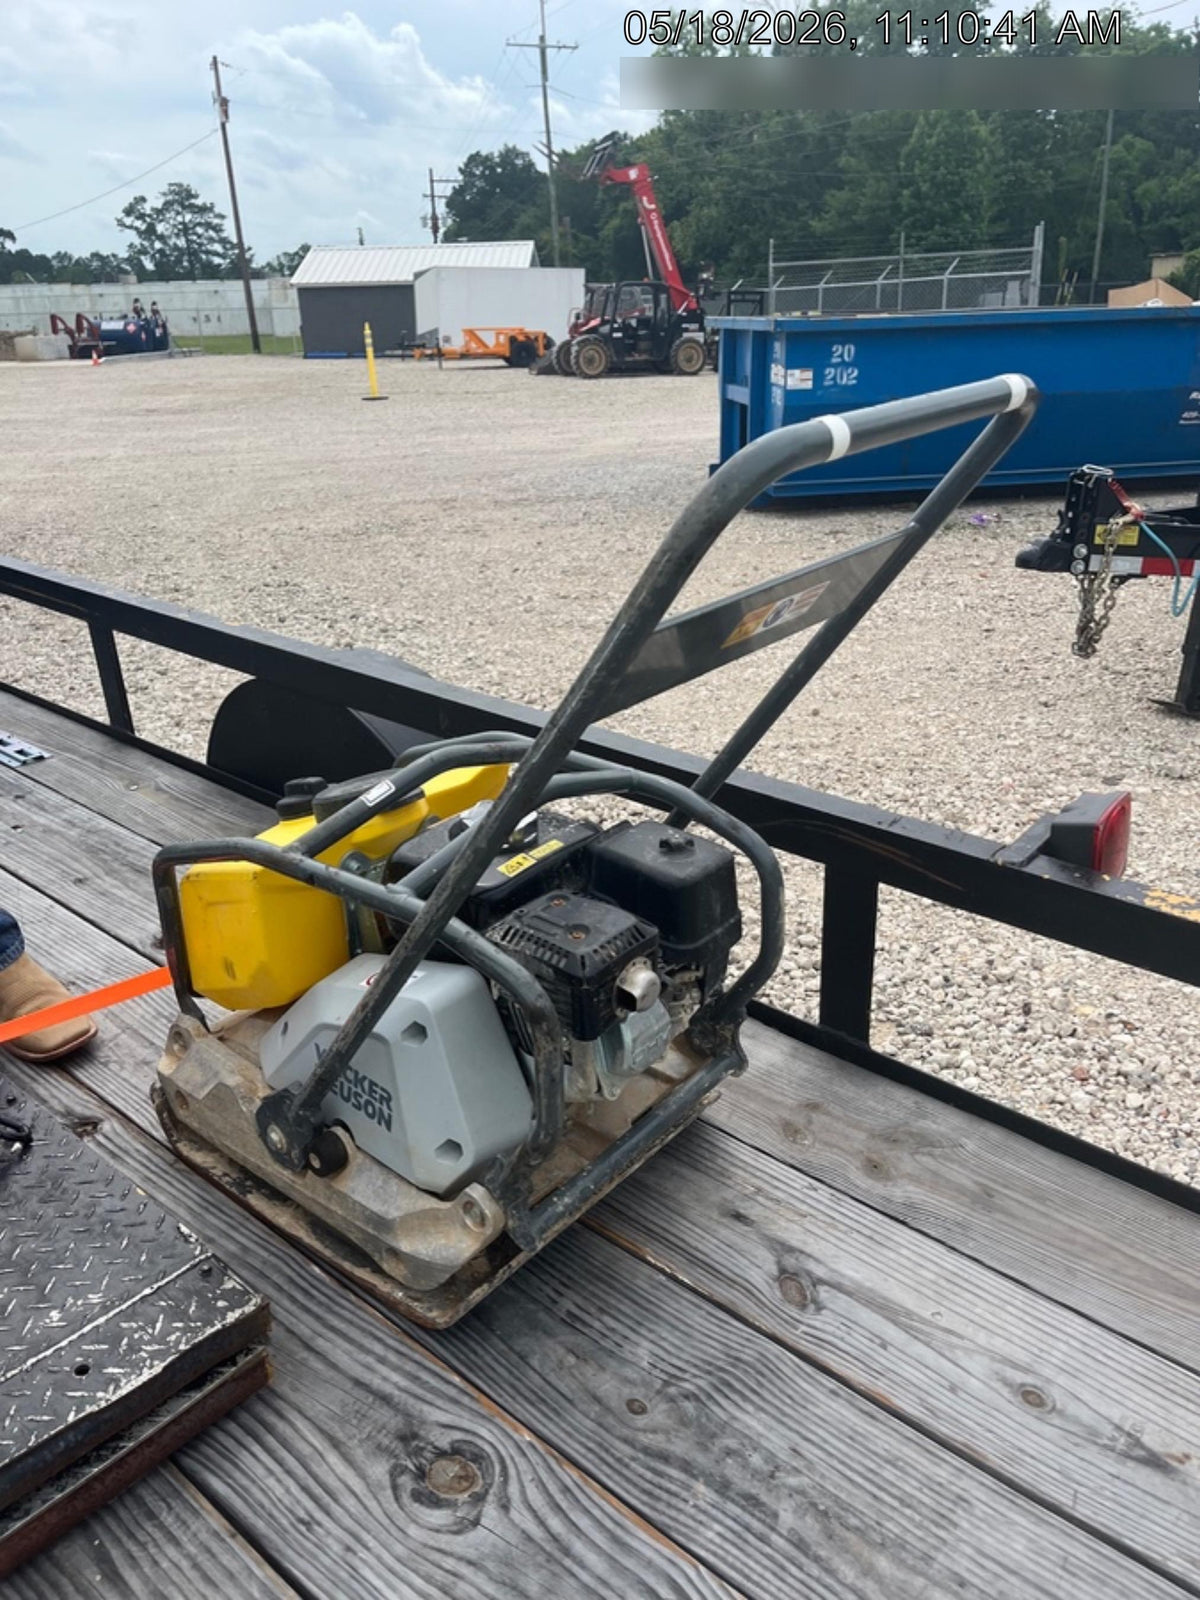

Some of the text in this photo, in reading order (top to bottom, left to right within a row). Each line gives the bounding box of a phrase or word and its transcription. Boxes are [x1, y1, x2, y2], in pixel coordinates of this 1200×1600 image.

[830, 343, 856, 364] 20
[822, 366, 859, 387] 202
[330, 1080, 393, 1133] EUSON
